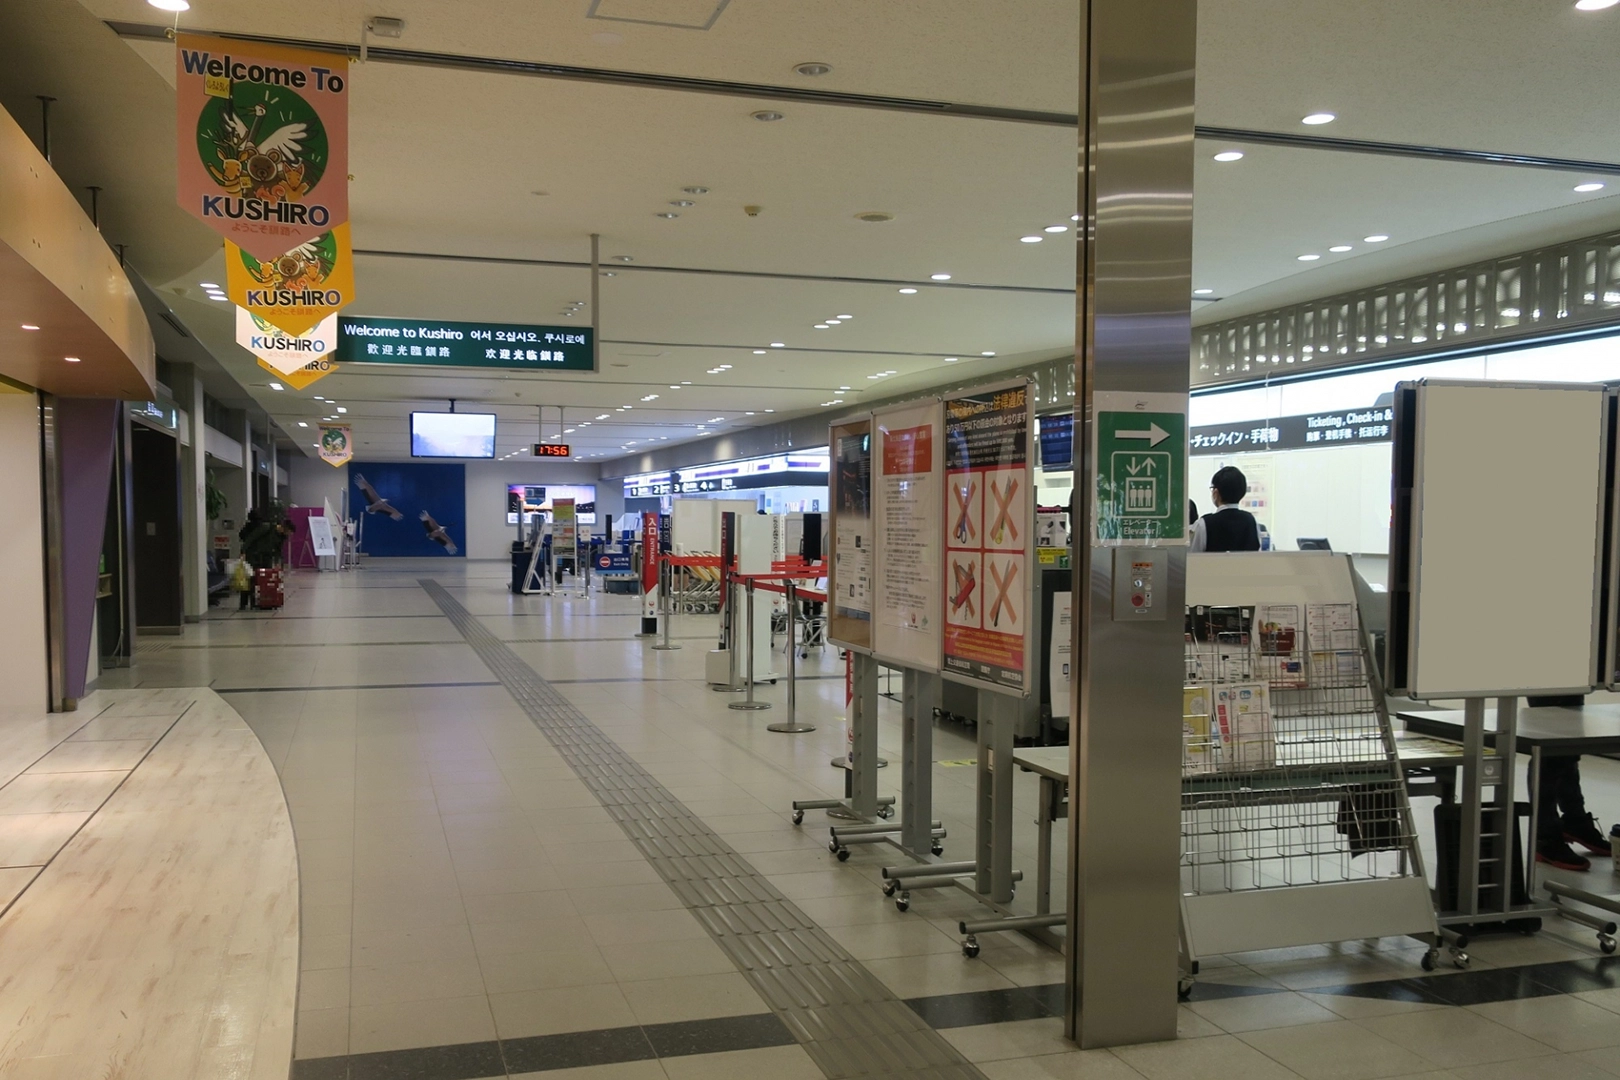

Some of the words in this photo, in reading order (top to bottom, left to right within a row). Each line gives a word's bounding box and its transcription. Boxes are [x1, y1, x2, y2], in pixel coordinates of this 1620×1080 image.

[181, 49, 306, 88] Welcome
[311, 66, 344, 93] To
[202, 195, 330, 226] KUSHIRO
[231, 223, 301, 237] ようこそ釧路へ
[247, 290, 341, 306] KUSHIRO
[344, 324, 400, 338] Welcome
[402, 327, 417, 338] to
[418, 327, 464, 340] Kushiro
[470, 329, 492, 342] 어서
[544, 332, 585, 345] 쿠시로에
[251, 336, 326, 353] KUSHIRO
[1346, 411, 1383, 424] Check-in
[1384, 408, 1393, 420] &
[539, 446, 568, 456] 17:56
[653, 486, 659, 494] 2
[674, 484, 680, 493] 3
[648, 517, 657, 535] 入口
[1123, 526, 1155, 535] Elevator
